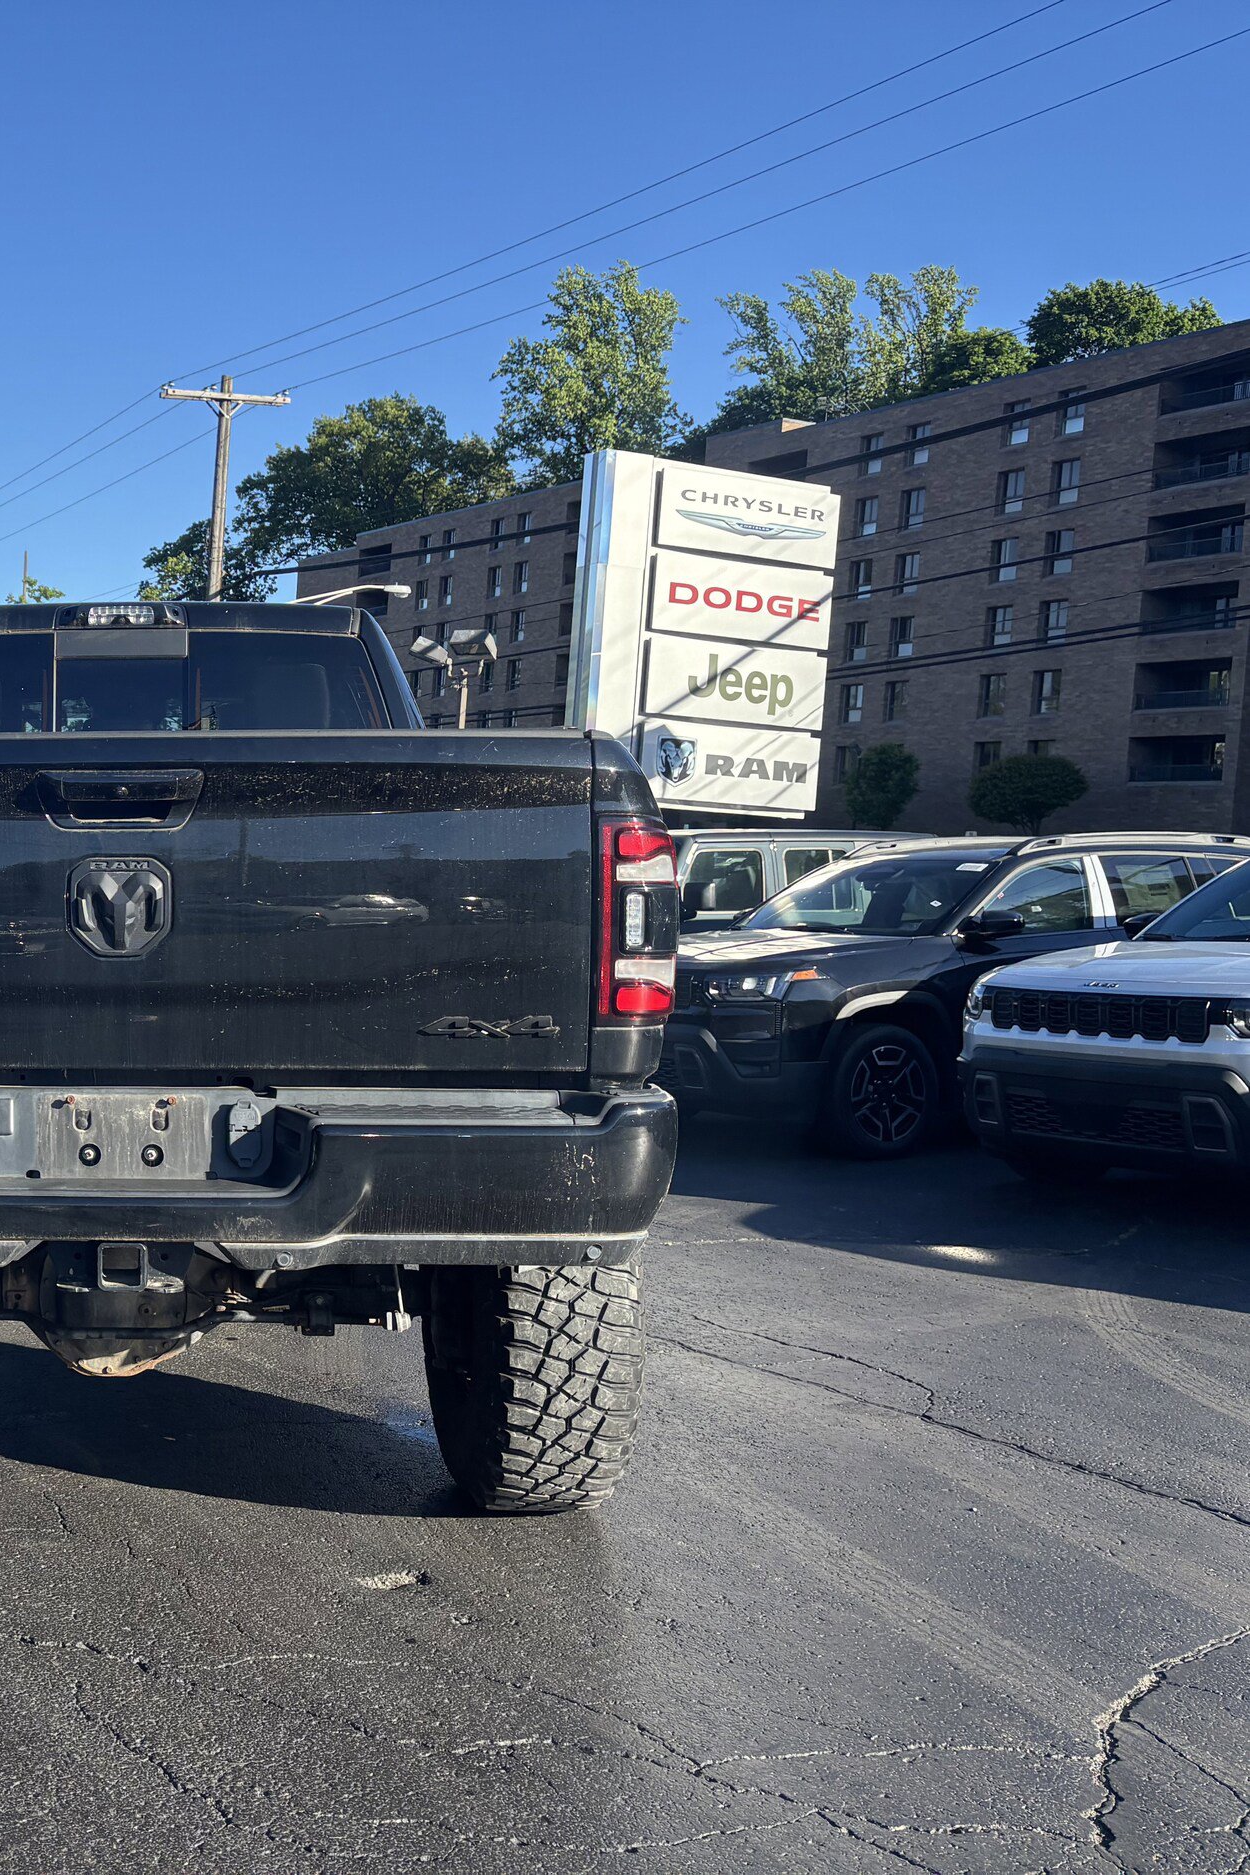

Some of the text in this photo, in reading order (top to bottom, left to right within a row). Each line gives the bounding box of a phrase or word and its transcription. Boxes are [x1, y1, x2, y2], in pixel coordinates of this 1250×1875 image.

[681, 489, 825, 522] CHRYSLER
[669, 582, 820, 622] DODGE
[688, 653, 794, 716] Jeep
[704, 754, 808, 784] RAM
[90, 861, 150, 870] RAM
